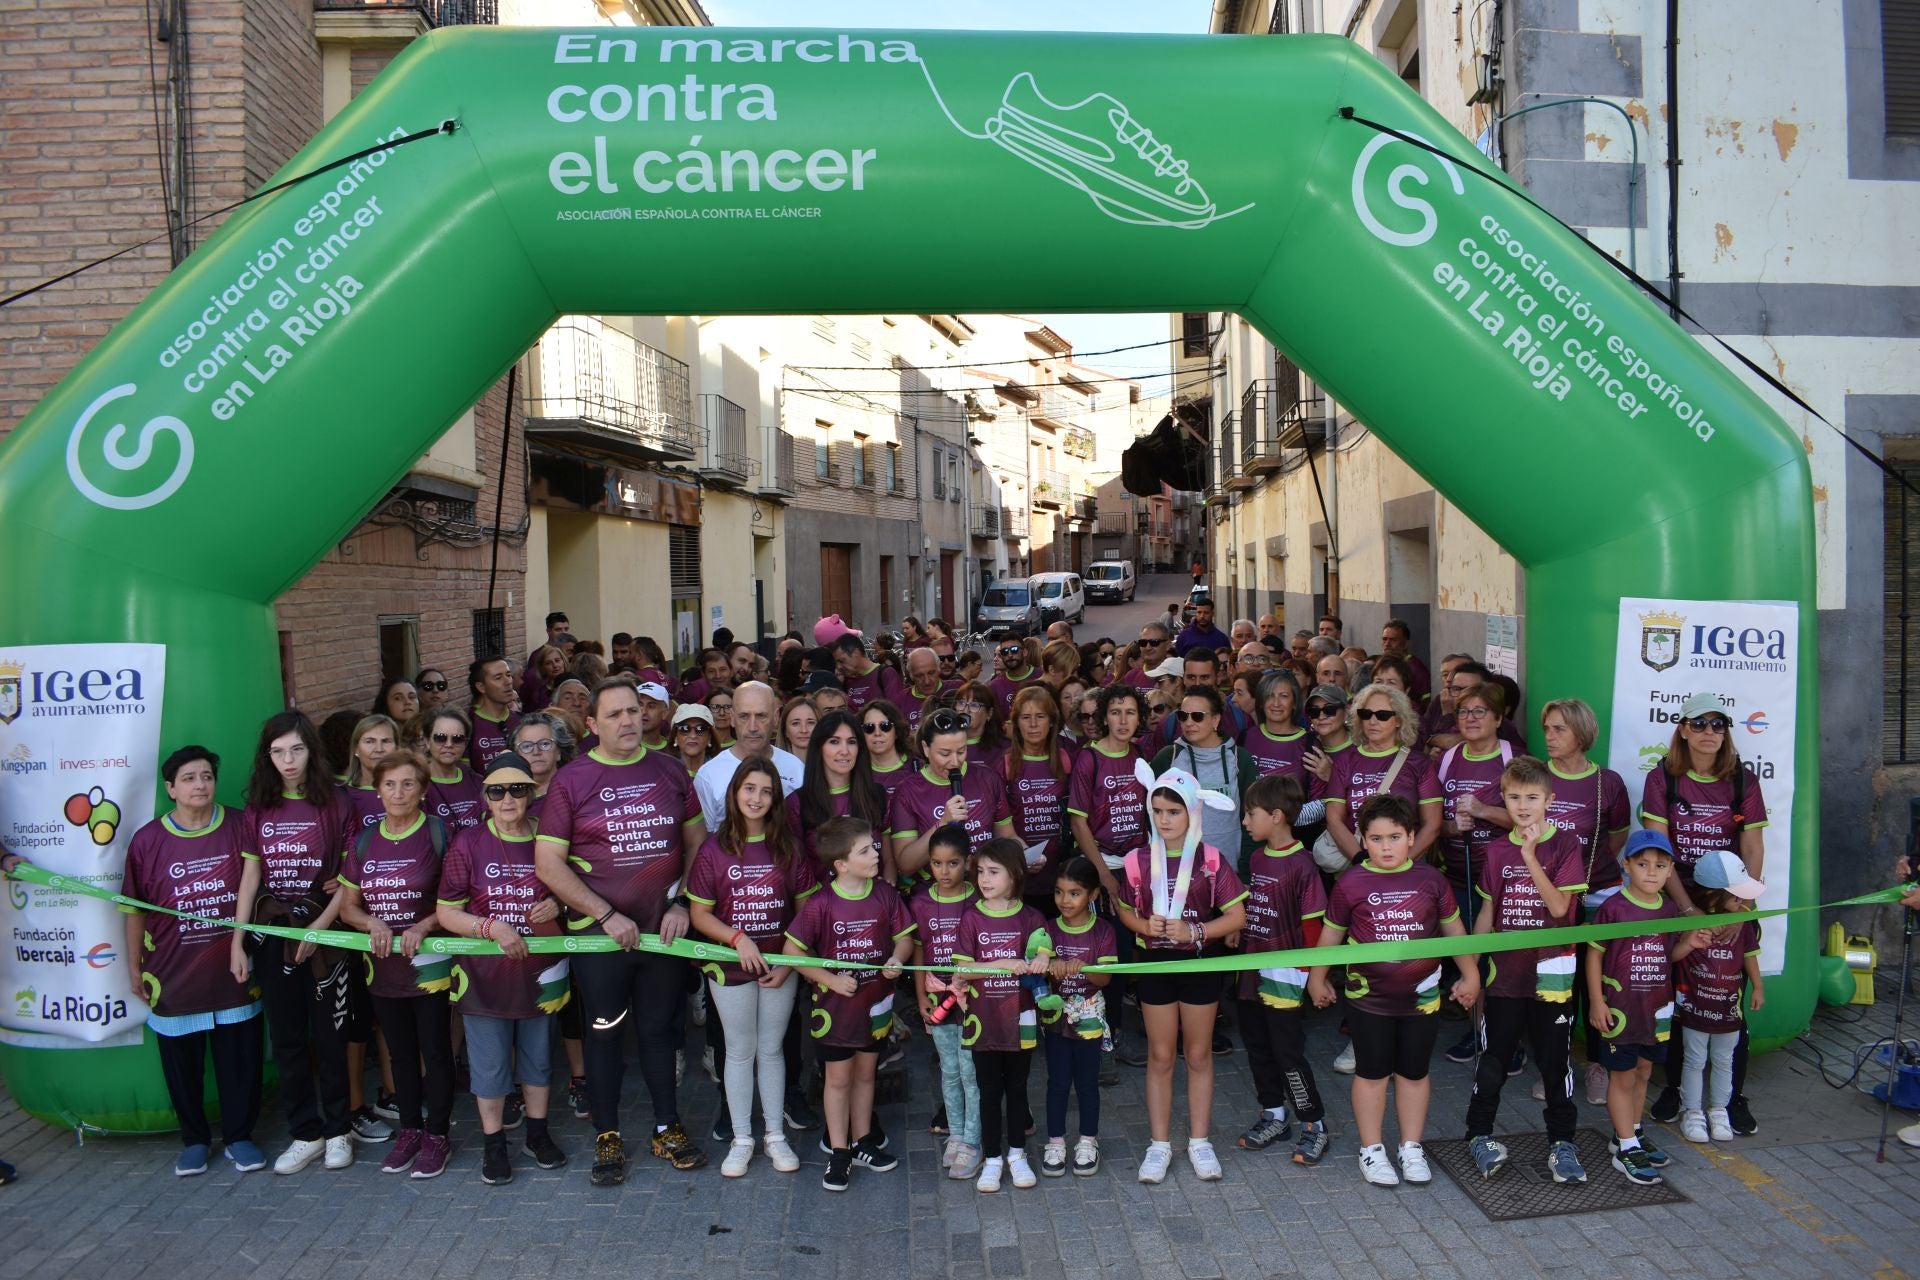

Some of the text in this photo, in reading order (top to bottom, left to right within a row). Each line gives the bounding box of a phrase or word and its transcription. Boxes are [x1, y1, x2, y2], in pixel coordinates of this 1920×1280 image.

[553, 34, 921, 64] En marcha
[546, 74, 777, 122] contra
[548, 135, 877, 195] el cáncer
[556, 205, 822, 220] ASOCIACIÓN ESPAÑOLA CONTRA EL CÁNCER
[159, 125, 409, 368] asociación española
[183, 196, 384, 394] contra el cáncer
[1432, 261, 1572, 402] en La Rioja
[1458, 237, 1649, 420] contra el cáncer
[1480, 215, 1716, 443] asociación española
[211, 274, 364, 421] en La Rioja
[1650, 691, 1735, 707] Fundón
[1, 756, 131, 774] Kingspan invesanel
[1035, 794, 1056, 803] Rioja
[1351, 789, 1363, 797] La
[1444, 799, 1453, 807] La
[605, 803, 655, 817] La Rioja
[13, 820, 65, 833] Fundación
[607, 815, 674, 831] En marcha
[965, 820, 981, 830] oja
[1035, 822, 1060, 831] cánce
[1676, 822, 1722, 834] La Rioja
[609, 830, 650, 842] contra
[1677, 835, 1690, 844] En
[21, 836, 65, 849] Deporte
[263, 842, 307, 854] La Rioja
[611, 839, 667, 853] el cáncer
[278, 857, 322, 867] marcha
[79, 872, 123, 884] española
[361, 877, 405, 888] La Rioja
[175, 879, 225, 896] La Rioja
[488, 885, 534, 898] La Rioja
[732, 885, 773, 896] La Rioja
[364, 890, 422, 901] En marcha
[48, 899, 58, 907] La
[60, 899, 78, 909] Rioja
[178, 900, 193, 911] En
[490, 901, 503, 910] En
[733, 899, 784, 910] En marcha
[732, 912, 767, 920] contra
[1387, 910, 1413, 920] Rioja
[1503, 907, 1532, 915] contra
[180, 922, 191, 932] el
[745, 921, 780, 931] cáncer
[1390, 922, 1424, 931] marcha
[1512, 917, 1544, 926] cáncer
[14, 928, 75, 941] Fundación
[837, 938, 872, 948] La Rioja
[1644, 943, 1664, 952] Rioja
[16, 946, 75, 966] Ibercaja
[995, 950, 1016, 959] Rioja
[1631, 955, 1642, 963] En
[1708, 949, 1733, 959] IGEA
[984, 978, 1019, 987] el cánce
[1631, 973, 1639, 981] el
[42, 994, 127, 1026] La Rioja
[1694, 1007, 1702, 1016] La
[1704, 1010, 1723, 1020] Rioja
